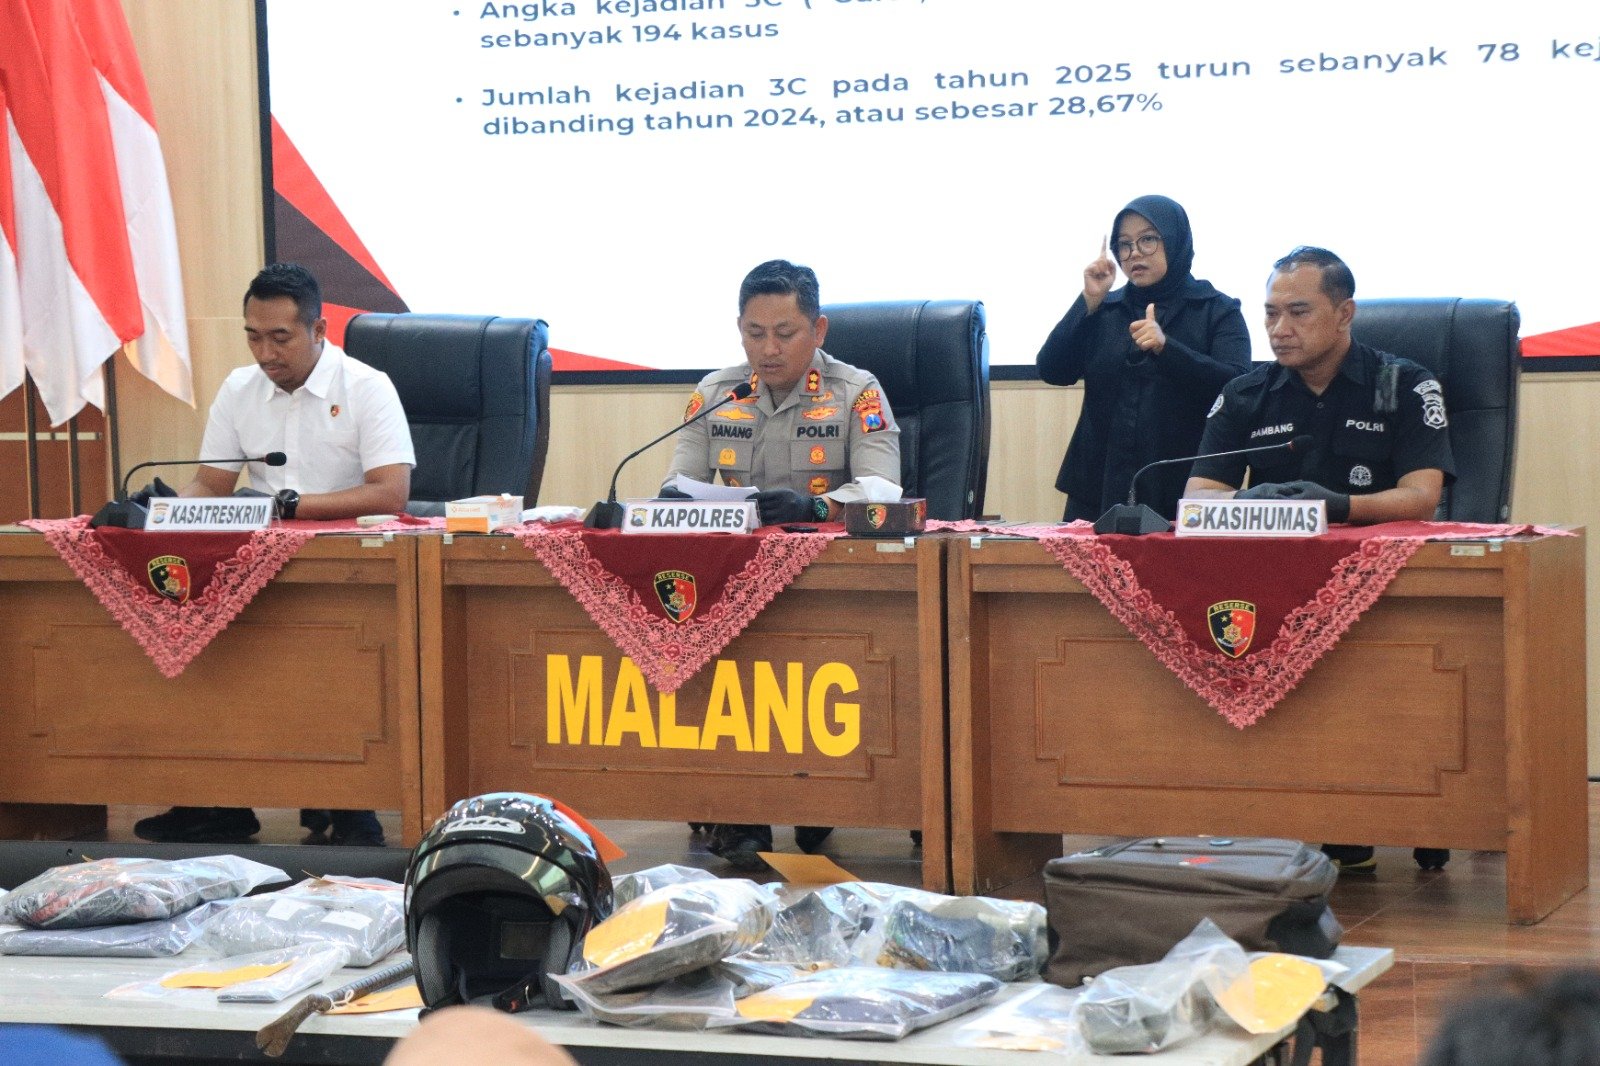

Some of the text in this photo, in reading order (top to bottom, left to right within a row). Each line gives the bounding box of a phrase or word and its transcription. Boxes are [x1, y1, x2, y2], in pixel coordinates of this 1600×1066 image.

[480, 0, 576, 21] Angka
[481, 22, 778, 49] sebanyak 194 kasus
[482, 85, 591, 106] Jumlah
[616, 81, 745, 105] kejadian
[770, 78, 806, 96] 3C
[833, 73, 908, 98] pada
[935, 70, 1028, 89] tahun
[1056, 63, 1131, 84] 2025
[1158, 62, 1250, 79] turun
[1280, 47, 1446, 73] sebanyak
[1478, 43, 1519, 63] 78
[483, 93, 1162, 135] dibanding tahun 2024, atau sebesar 28,67%
[711, 424, 753, 439] DANANG
[796, 425, 840, 438] POLRI
[1346, 419, 1385, 432] POLRI
[169, 505, 267, 524] KASATRESKRIM
[651, 508, 745, 528] KAPOLRES
[1203, 506, 1318, 532] KASIHUMAS
[1213, 602, 1250, 611] RESERSE
[546, 653, 861, 757] MALANG
